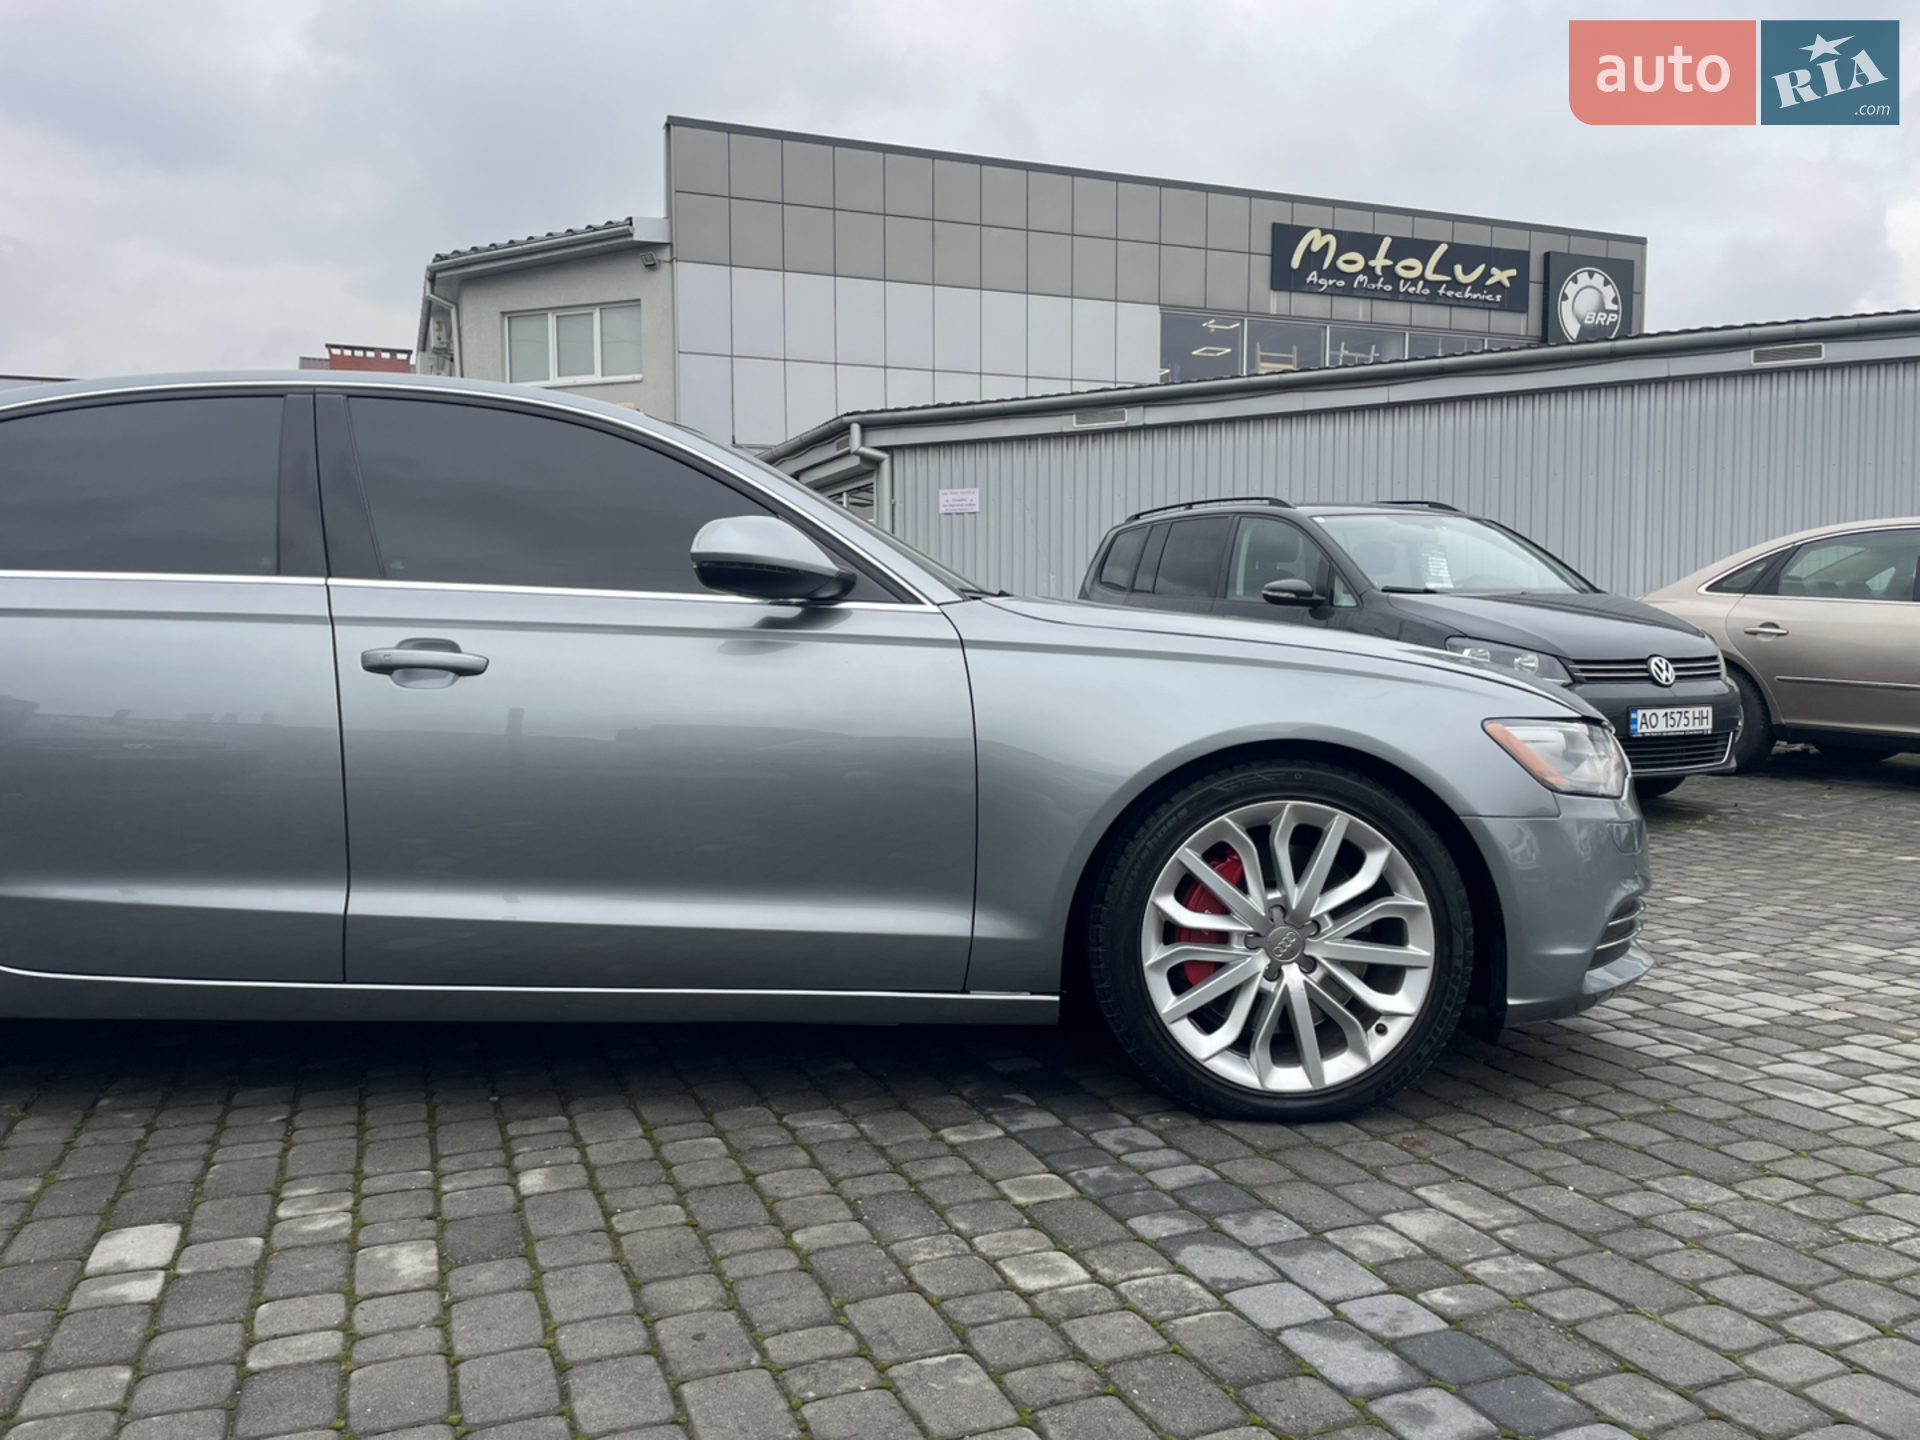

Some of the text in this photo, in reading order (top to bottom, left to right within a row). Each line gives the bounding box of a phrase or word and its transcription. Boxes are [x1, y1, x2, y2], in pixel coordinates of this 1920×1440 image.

[1290, 228, 1518, 288] MotoLux
[1305, 270, 1503, 303] Agro Moto Velo technics
[1583, 311, 1618, 327] BRP
[1639, 709, 1709, 730] AO 1575 HH
